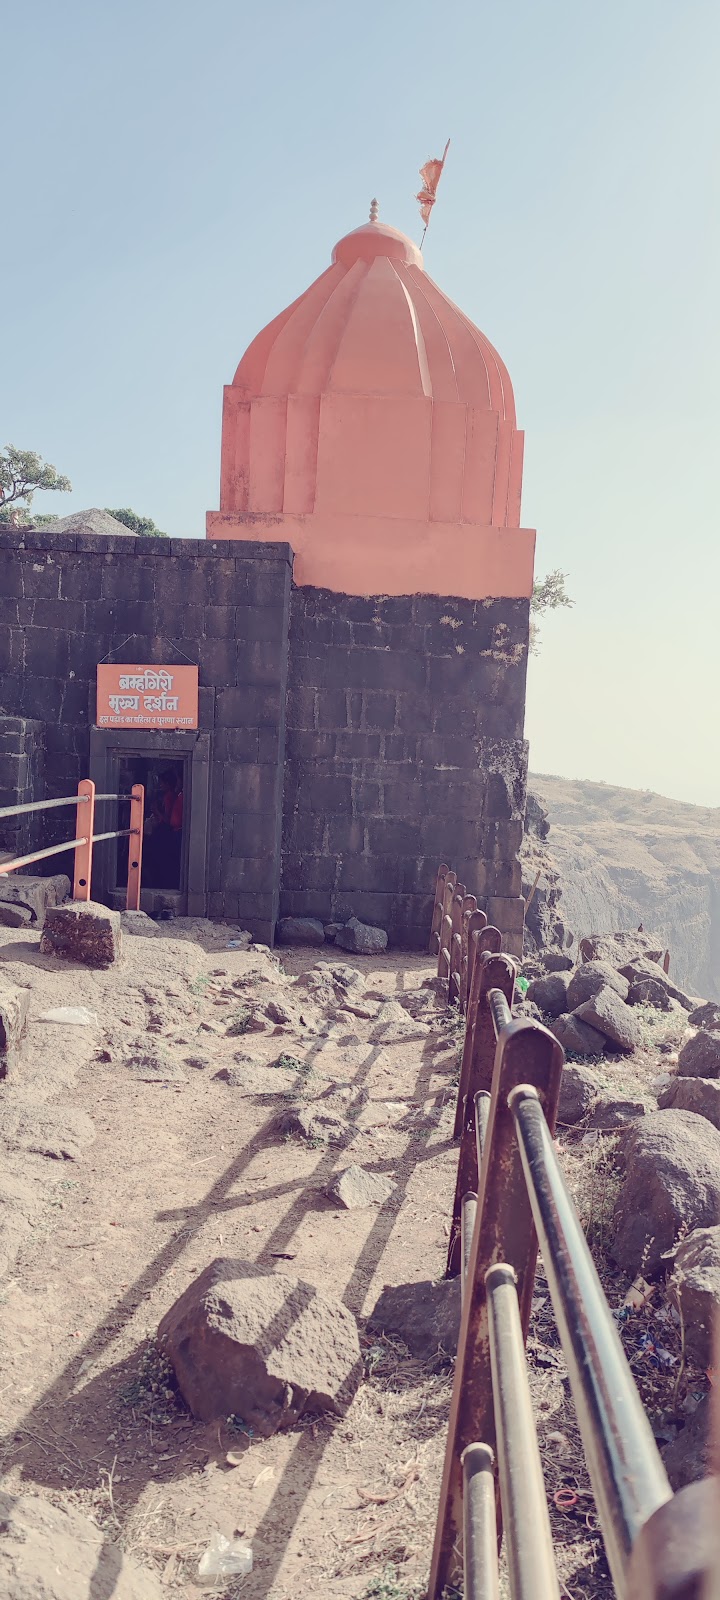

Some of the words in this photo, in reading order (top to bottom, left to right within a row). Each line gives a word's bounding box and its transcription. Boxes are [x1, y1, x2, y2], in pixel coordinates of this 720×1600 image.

[119, 669, 174, 693] ब्रम्हगिरी
[108, 694, 140, 714] मुख्य
[143, 691, 179, 712] दर्शन
[99, 715, 109, 725] इस
[125, 716, 133, 724] का
